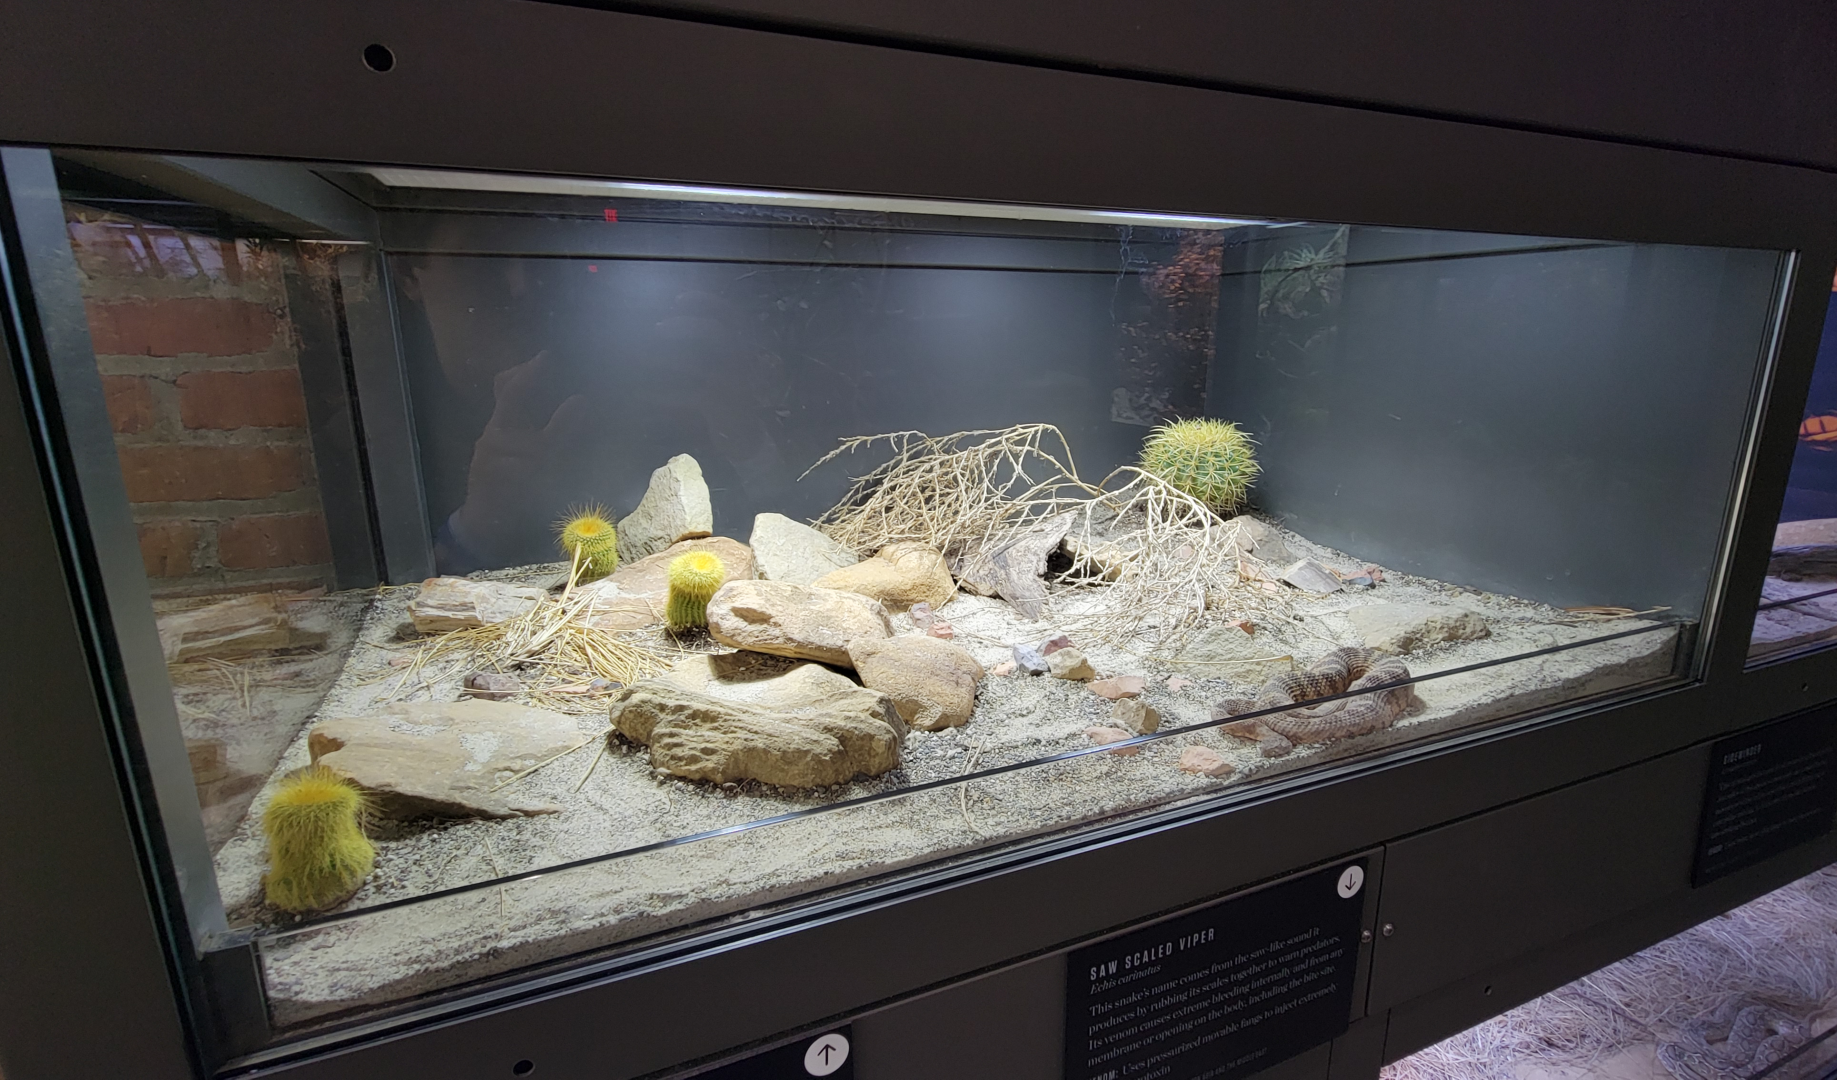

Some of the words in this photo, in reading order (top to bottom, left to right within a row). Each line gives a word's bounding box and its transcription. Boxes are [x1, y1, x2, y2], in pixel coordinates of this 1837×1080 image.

[1088, 1010, 1135, 1037] produces
[1136, 1006, 1150, 1018] by
[1150, 992, 1188, 1012] rubbing
[1188, 988, 1201, 998] its
[1202, 976, 1230, 993] scales
[1230, 962, 1267, 984] together
[1268, 958, 1278, 968] to
[1278, 950, 1302, 964] warn
[1088, 1039, 1102, 1051] Its
[1104, 1026, 1138, 1044] venom
[1139, 1013, 1171, 1032] causes
[1172, 998, 1211, 1019] extreme
[1212, 984, 1250, 1004] bleeding
[1251, 967, 1292, 990] internally
[1292, 962, 1308, 973] and
[1309, 953, 1329, 967] from
[1329, 948, 1345, 960] any
[1089, 1002, 1113, 1017] This
[1114, 988, 1150, 1008] snake's
[1151, 979, 1178, 996] name
[1179, 968, 1209, 986] comes
[1211, 960, 1233, 974] from
[1234, 954, 1250, 966] the
[1250, 940, 1286, 959] saw-like
[1286, 928, 1312, 946] sound
[1313, 926, 1320, 937] it
[1090, 960, 1118, 981] SAW
[1125, 942, 1172, 969] SCALED
[1179, 928, 1215, 951] VIPER
[1090, 979, 1116, 995] Echis
[1118, 964, 1162, 985] carinatus
[1087, 1041, 1142, 1068] membrane
[1142, 1036, 1155, 1046] or
[1155, 1021, 1193, 1044] opening
[1194, 1014, 1206, 1026] on
[1208, 1009, 1223, 1022] the
[1248, 984, 1288, 1005] including
[1288, 977, 1302, 988] the
[1303, 971, 1319, 983] bite
[1122, 1059, 1145, 1075] Uses
[1146, 1035, 1201, 1068] pressurized
[1202, 1023, 1239, 1044] movable
[1240, 1013, 1263, 1029] fangs
[1264, 1010, 1274, 1019] to
[1274, 1000, 1298, 1015] inject
[1298, 982, 1338, 1005] extremely
